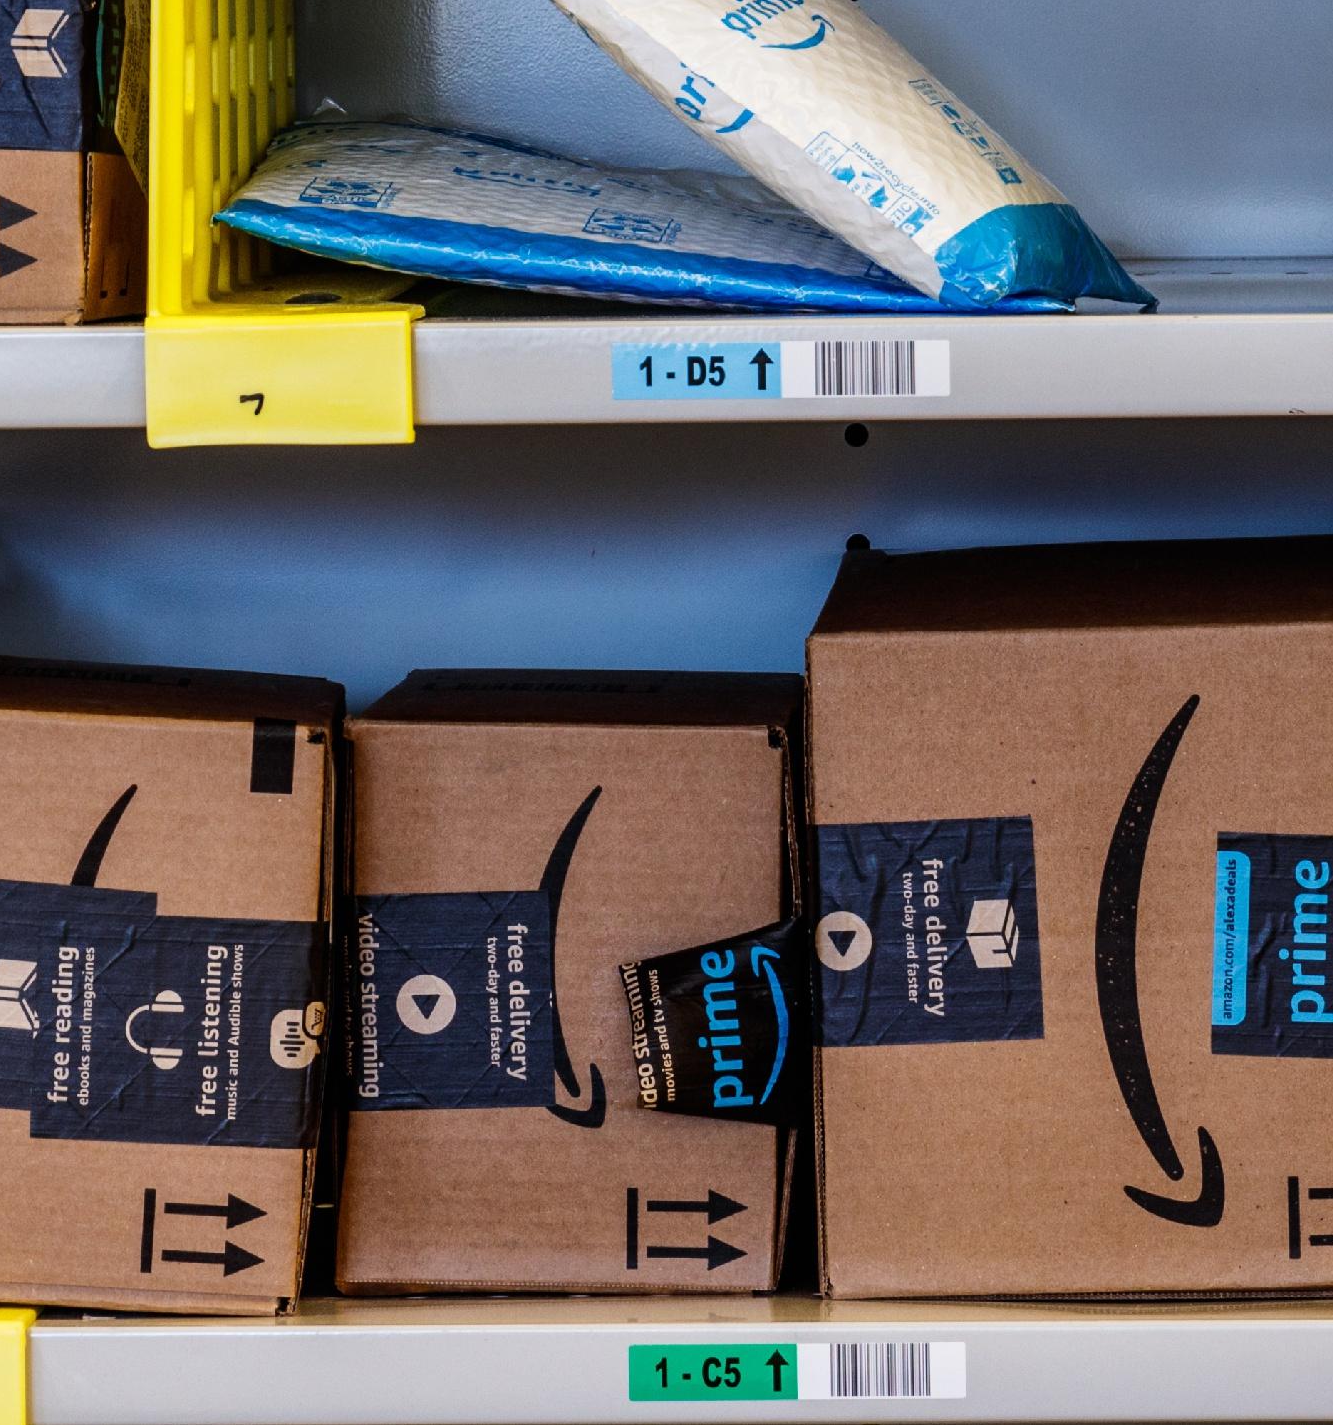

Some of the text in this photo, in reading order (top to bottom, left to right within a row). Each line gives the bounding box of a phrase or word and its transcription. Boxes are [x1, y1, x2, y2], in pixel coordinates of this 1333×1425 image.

[639, 356, 726, 387] 1 D5
[359, 913, 385, 1098] video streaming
[486, 937, 503, 1067] two-day and faster
[506, 923, 530, 1082] free delivery
[902, 872, 920, 1003] two-day and faster
[922, 858, 947, 1017] free delivery
[1223, 858, 1236, 1020] amazon.com/alexadeals
[47, 946, 79, 1103] free reading
[77, 947, 96, 1106] ebooks and magazines
[196, 945, 228, 1116] free listening
[227, 944, 244, 1120] music and Audible shows
[649, 969, 675, 1101] movies and tv shows
[698, 949, 754, 1108] prime
[655, 1357, 742, 1388] 1 C5
